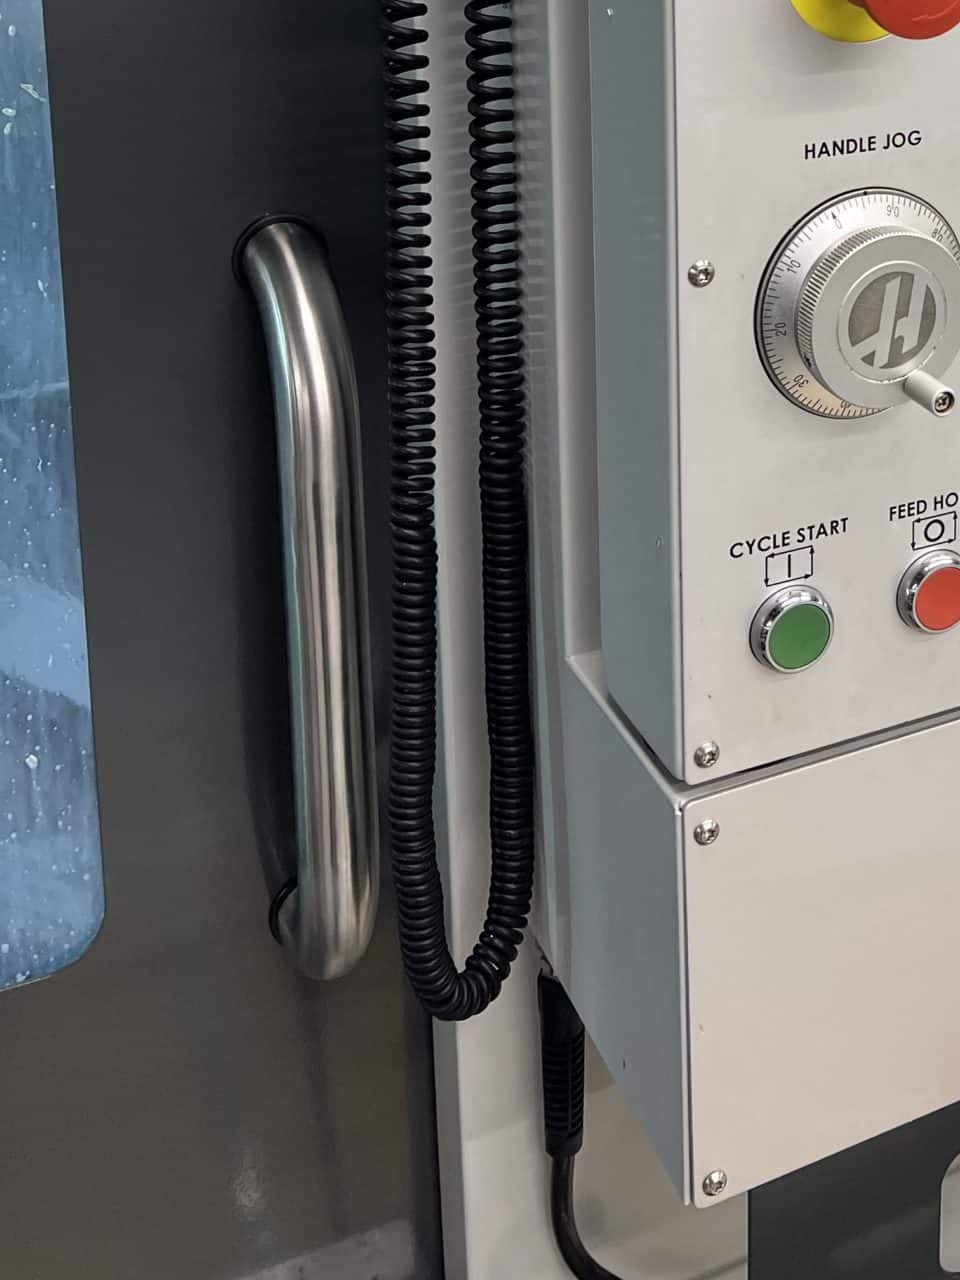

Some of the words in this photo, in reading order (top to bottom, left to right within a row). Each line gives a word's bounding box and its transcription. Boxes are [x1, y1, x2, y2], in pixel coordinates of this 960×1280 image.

[804, 136, 877, 160] HANDLE
[883, 130, 922, 151] JOG
[887, 205, 899, 218] 90
[932, 228, 943, 243] 80
[787, 260, 800, 274] 10
[776, 323, 786, 337] 20
[794, 375, 809, 387] 30
[889, 499, 928, 522] FEED
[729, 531, 790, 559] CYCLE
[796, 517, 849, 543] START
